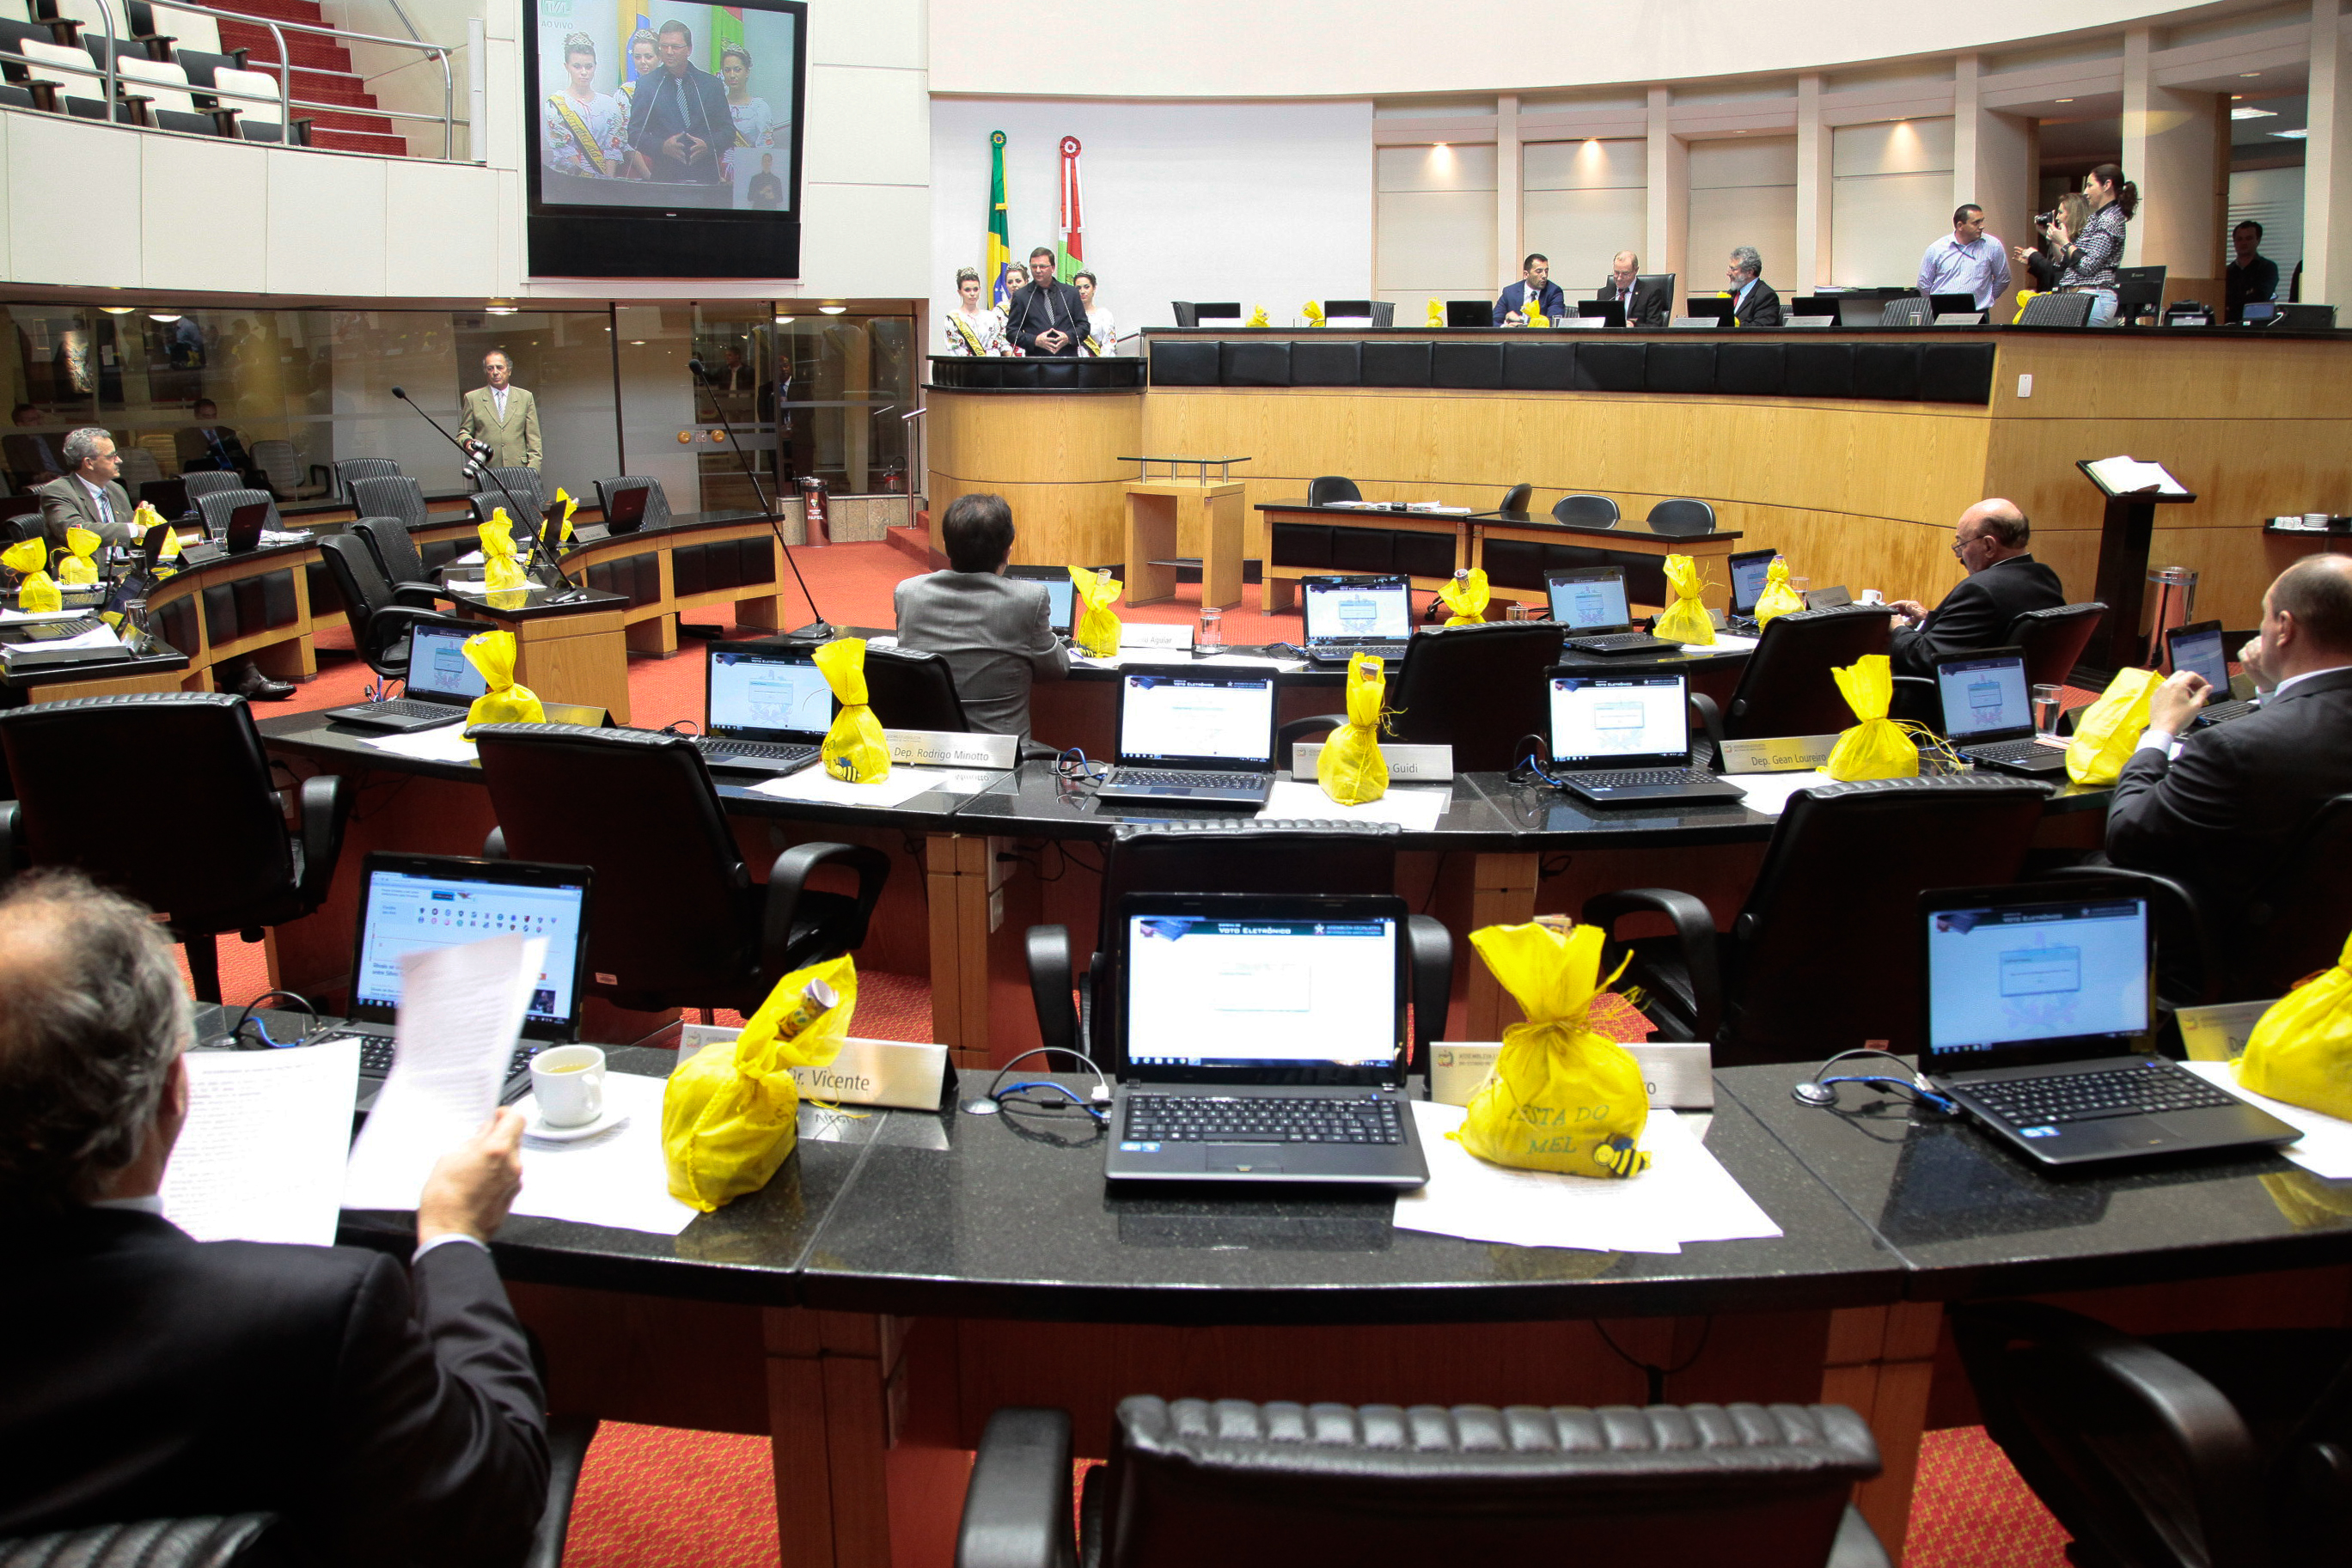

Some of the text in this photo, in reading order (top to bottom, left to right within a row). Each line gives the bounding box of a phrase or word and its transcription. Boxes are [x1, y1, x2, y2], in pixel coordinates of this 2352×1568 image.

[1151, 636, 1172, 644] Aguiar
[895, 747, 989, 761] Dep. Rodrigo Minotto
[1751, 752, 1827, 767] Dep. Gean Loureiro
[1392, 763, 1418, 773] Guidi
[812, 1070, 870, 1091] Vicente
[1575, 1105, 1610, 1123] DO
[1526, 1136, 1577, 1155] MEL
